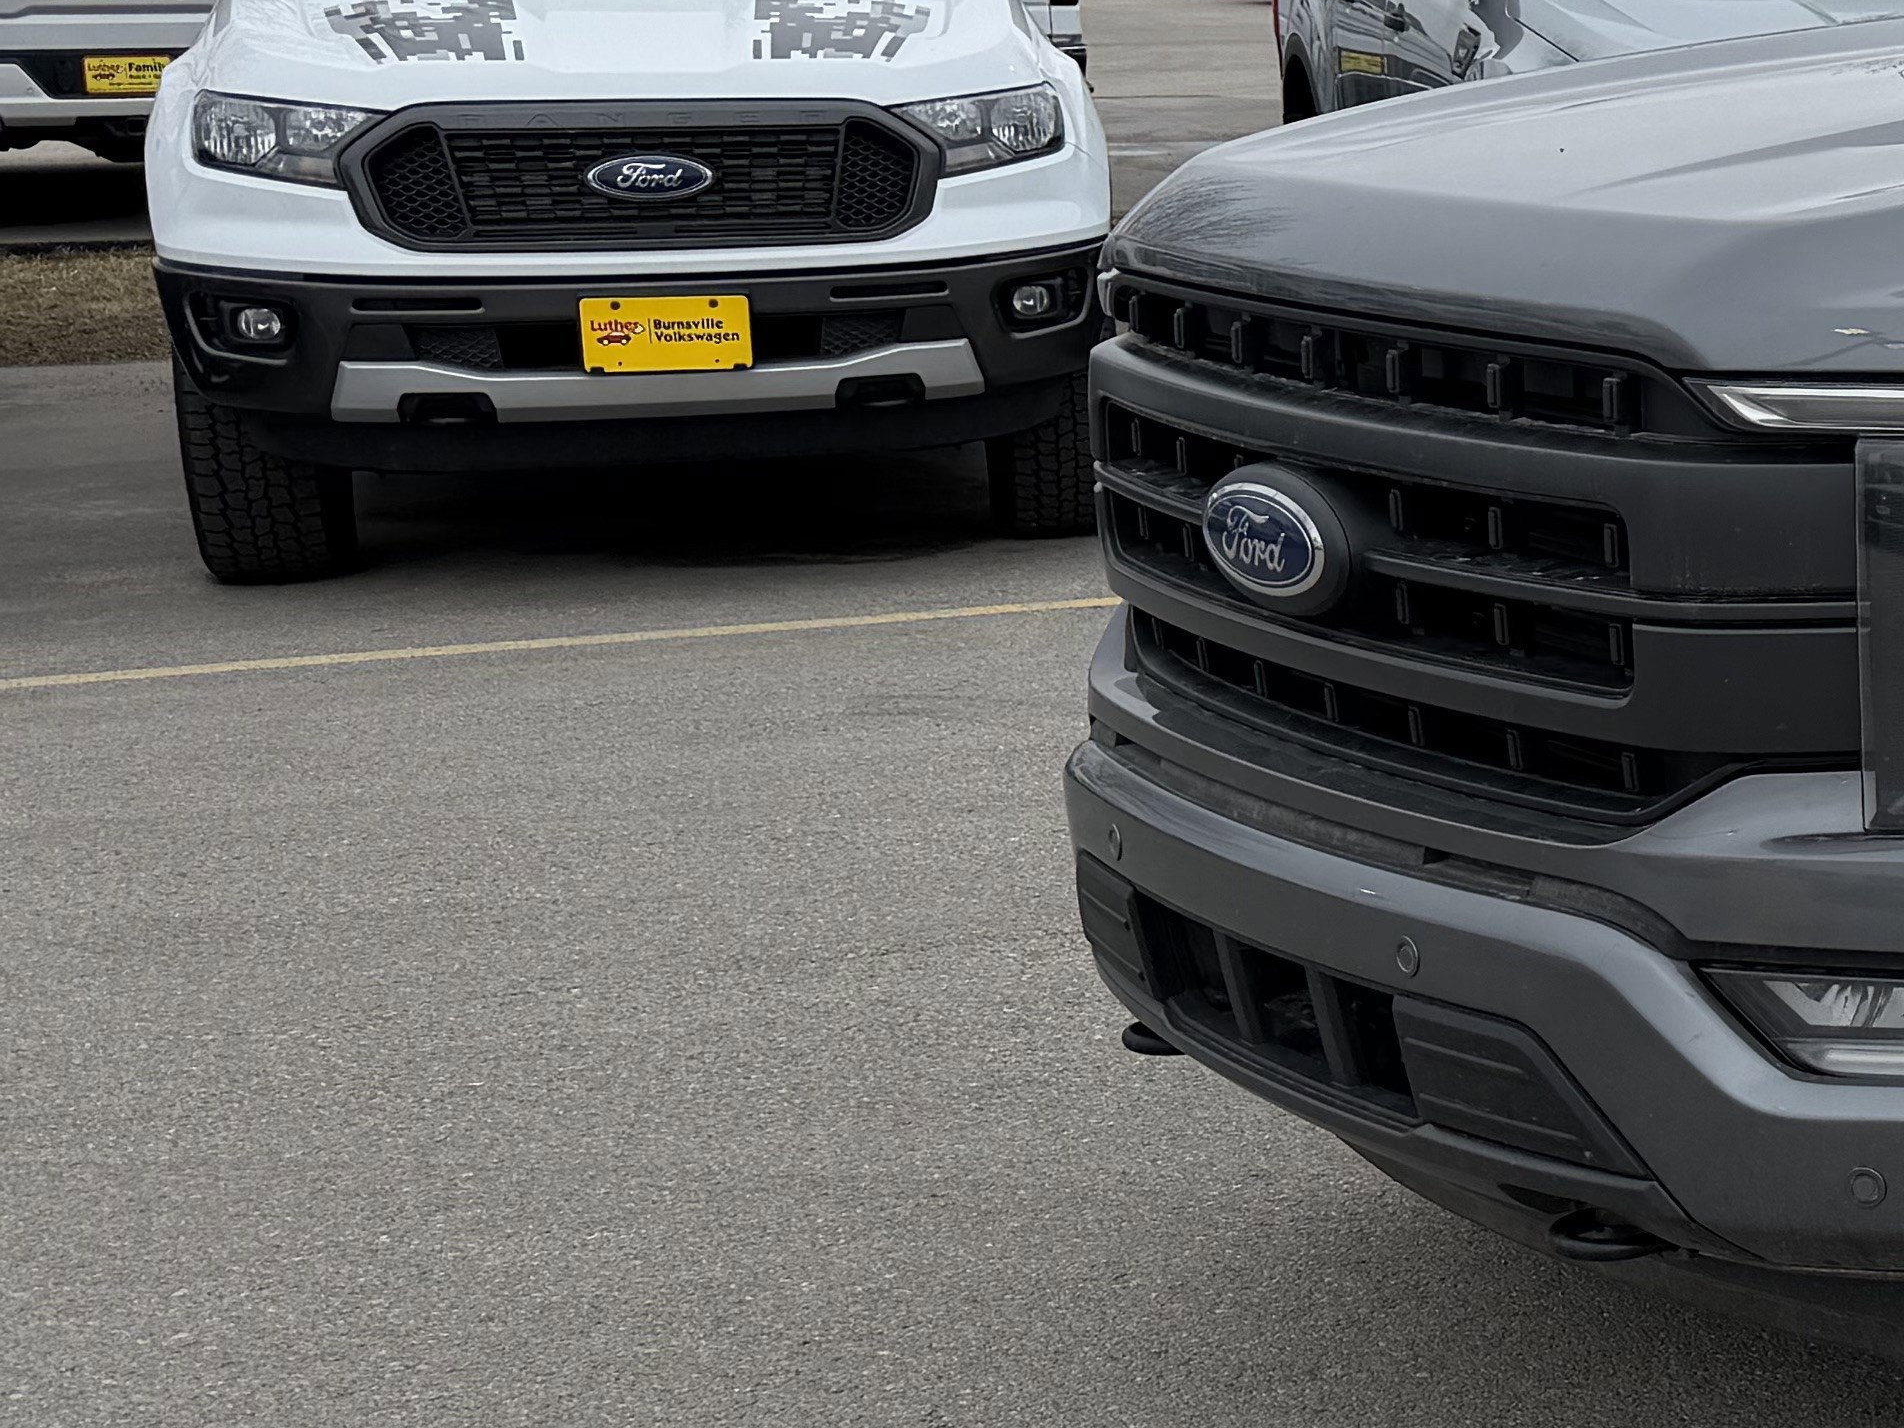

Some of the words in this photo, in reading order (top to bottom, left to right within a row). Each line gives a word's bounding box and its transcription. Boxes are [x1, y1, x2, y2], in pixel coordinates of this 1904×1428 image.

[455, 110, 826, 127] RANGER
[617, 162, 685, 189] Ford
[653, 317, 724, 331] Burnsville
[654, 330, 741, 345] Volkswagen
[1222, 504, 1286, 573] Ford
